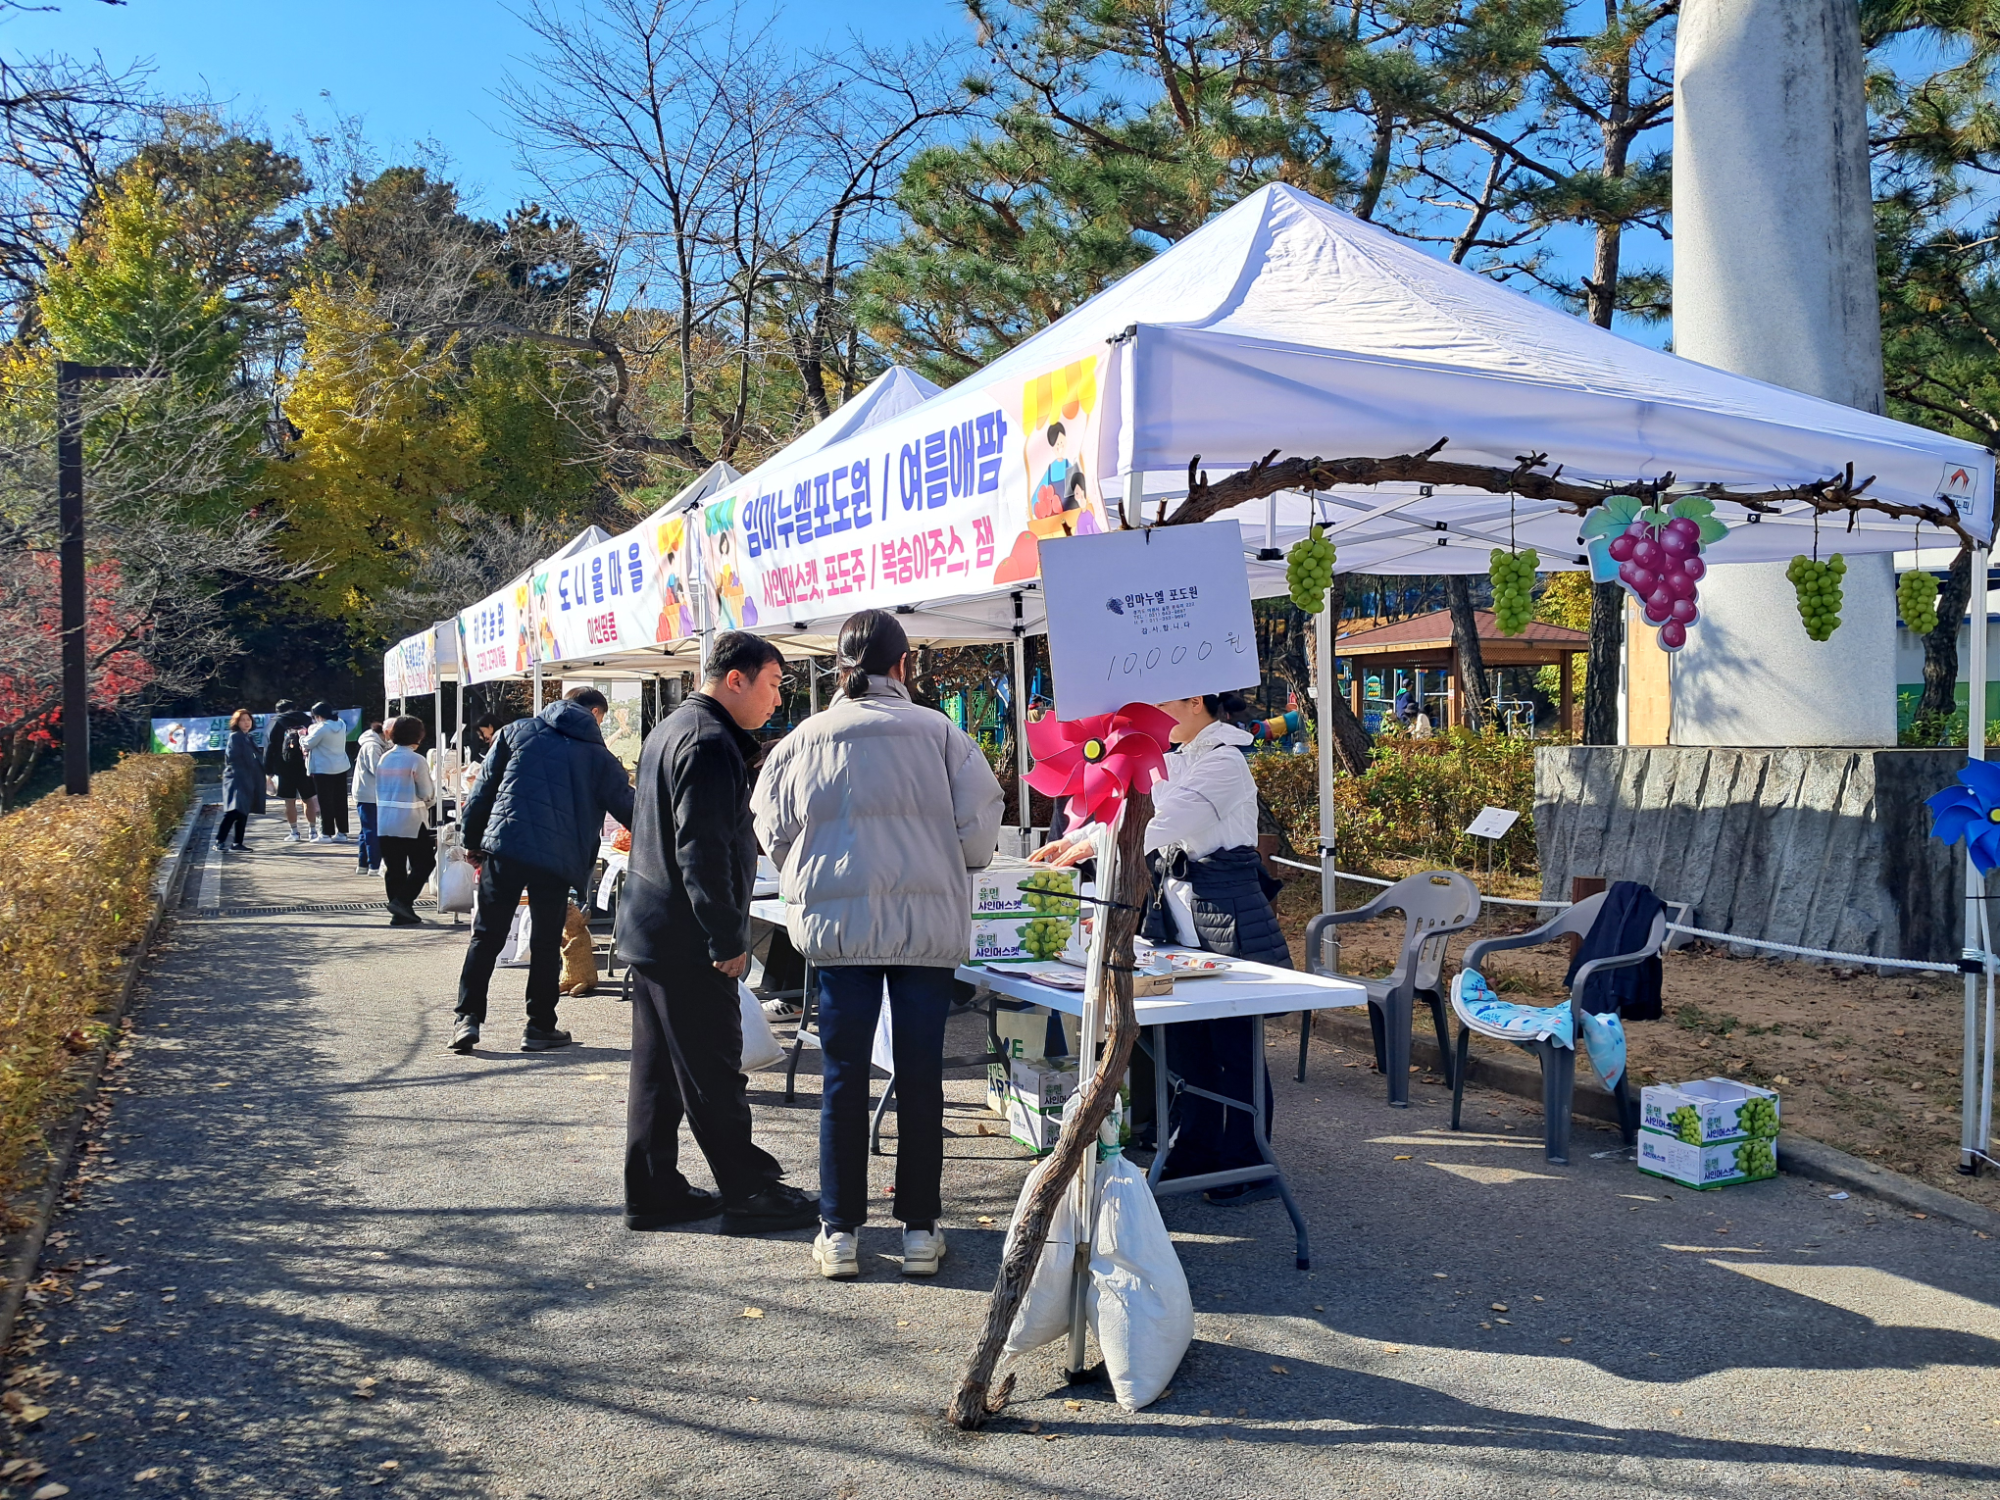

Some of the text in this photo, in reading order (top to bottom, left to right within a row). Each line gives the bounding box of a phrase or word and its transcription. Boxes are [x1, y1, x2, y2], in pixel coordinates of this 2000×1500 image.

[742, 409, 1007, 558] 임마누엘포도원 / 여름애팜
[824, 548, 866, 596] 포도주
[871, 544, 876, 590] /
[881, 525, 969, 585] 복숭아주스,
[972, 515, 994, 568] 잼
[1125, 586, 1198, 608] 임마누엘 포도원
[587, 611, 618, 644] 이천땅콩
[1107, 632, 1247, 681] 10,000 원
